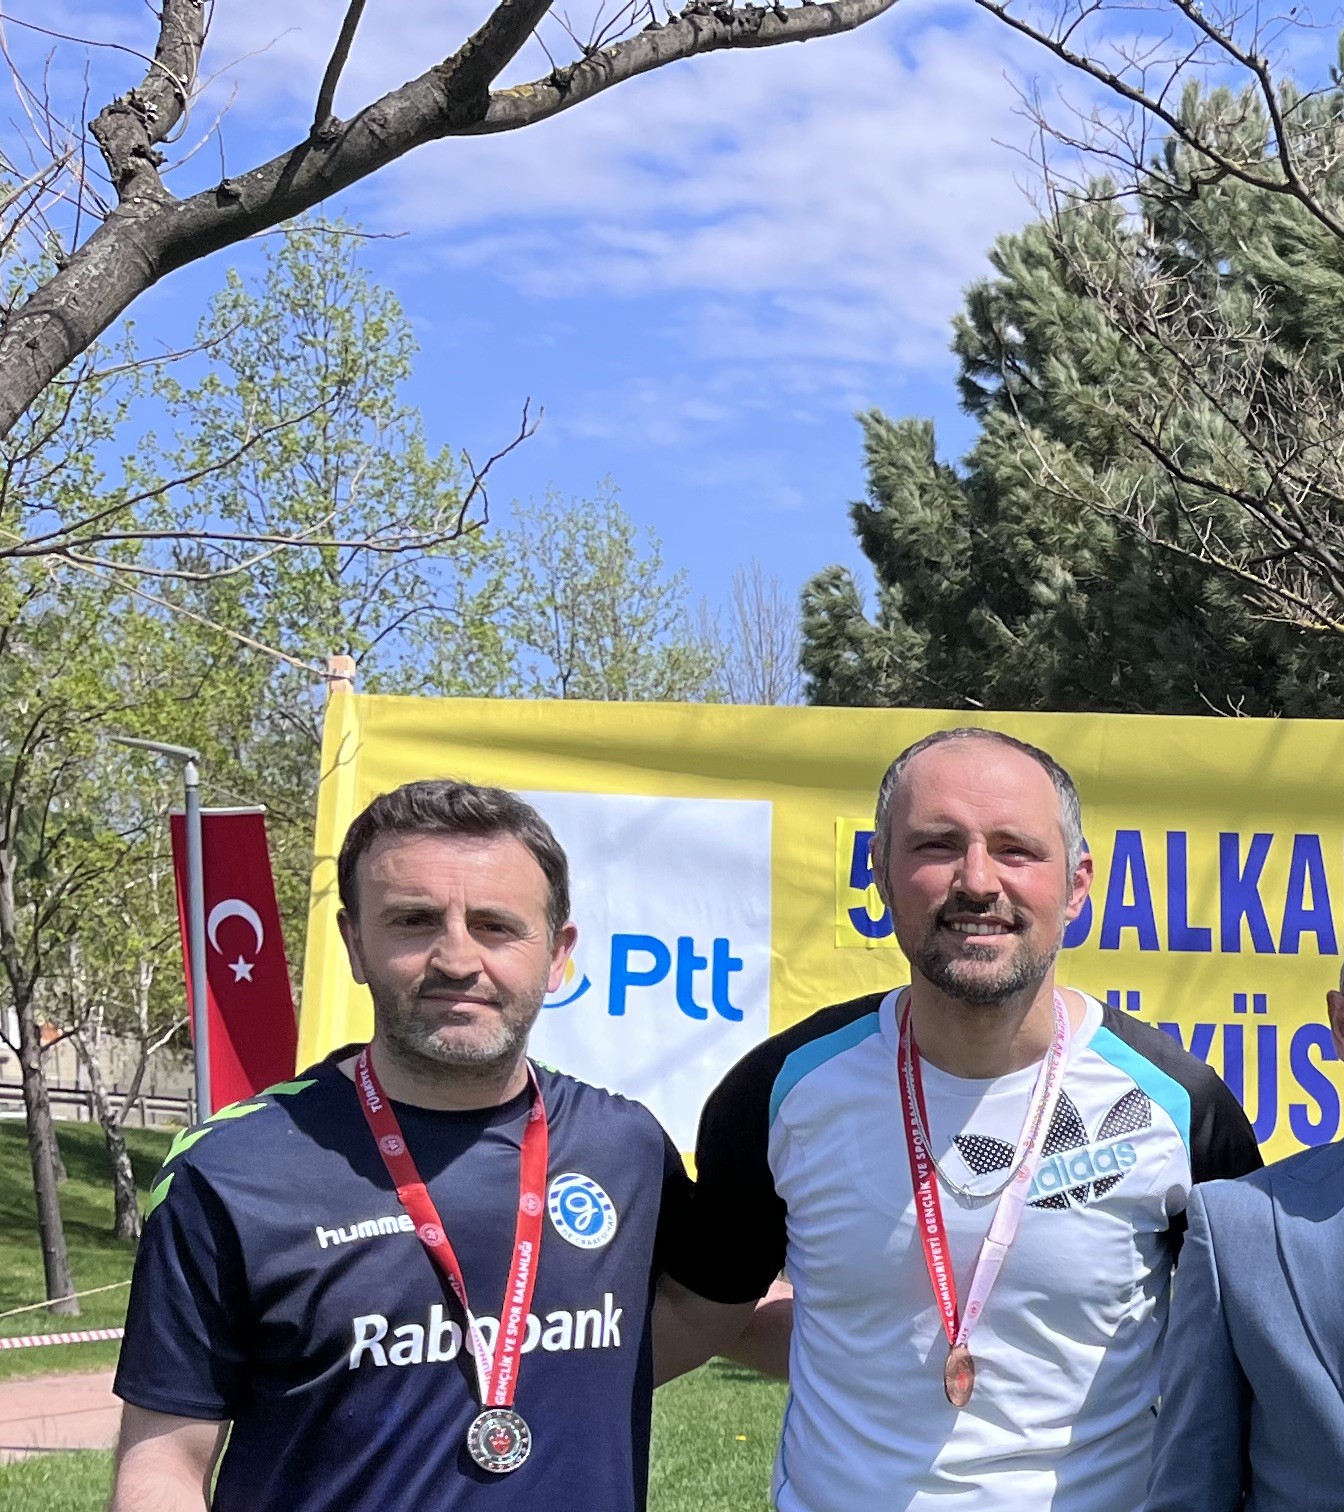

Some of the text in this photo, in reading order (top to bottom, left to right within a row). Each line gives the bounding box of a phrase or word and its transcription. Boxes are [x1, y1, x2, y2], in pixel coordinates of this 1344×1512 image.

[608, 933, 744, 1022] Ptt
[916, 1162, 929, 1179] VE
[315, 1214, 417, 1249] humme
[917, 1180, 938, 1234] GENÇLİK
[925, 1236, 954, 1318] CUMHURİYETİ
[490, 1239, 533, 1405] GENÇLİK VE SPOR BAKANLIĞI
